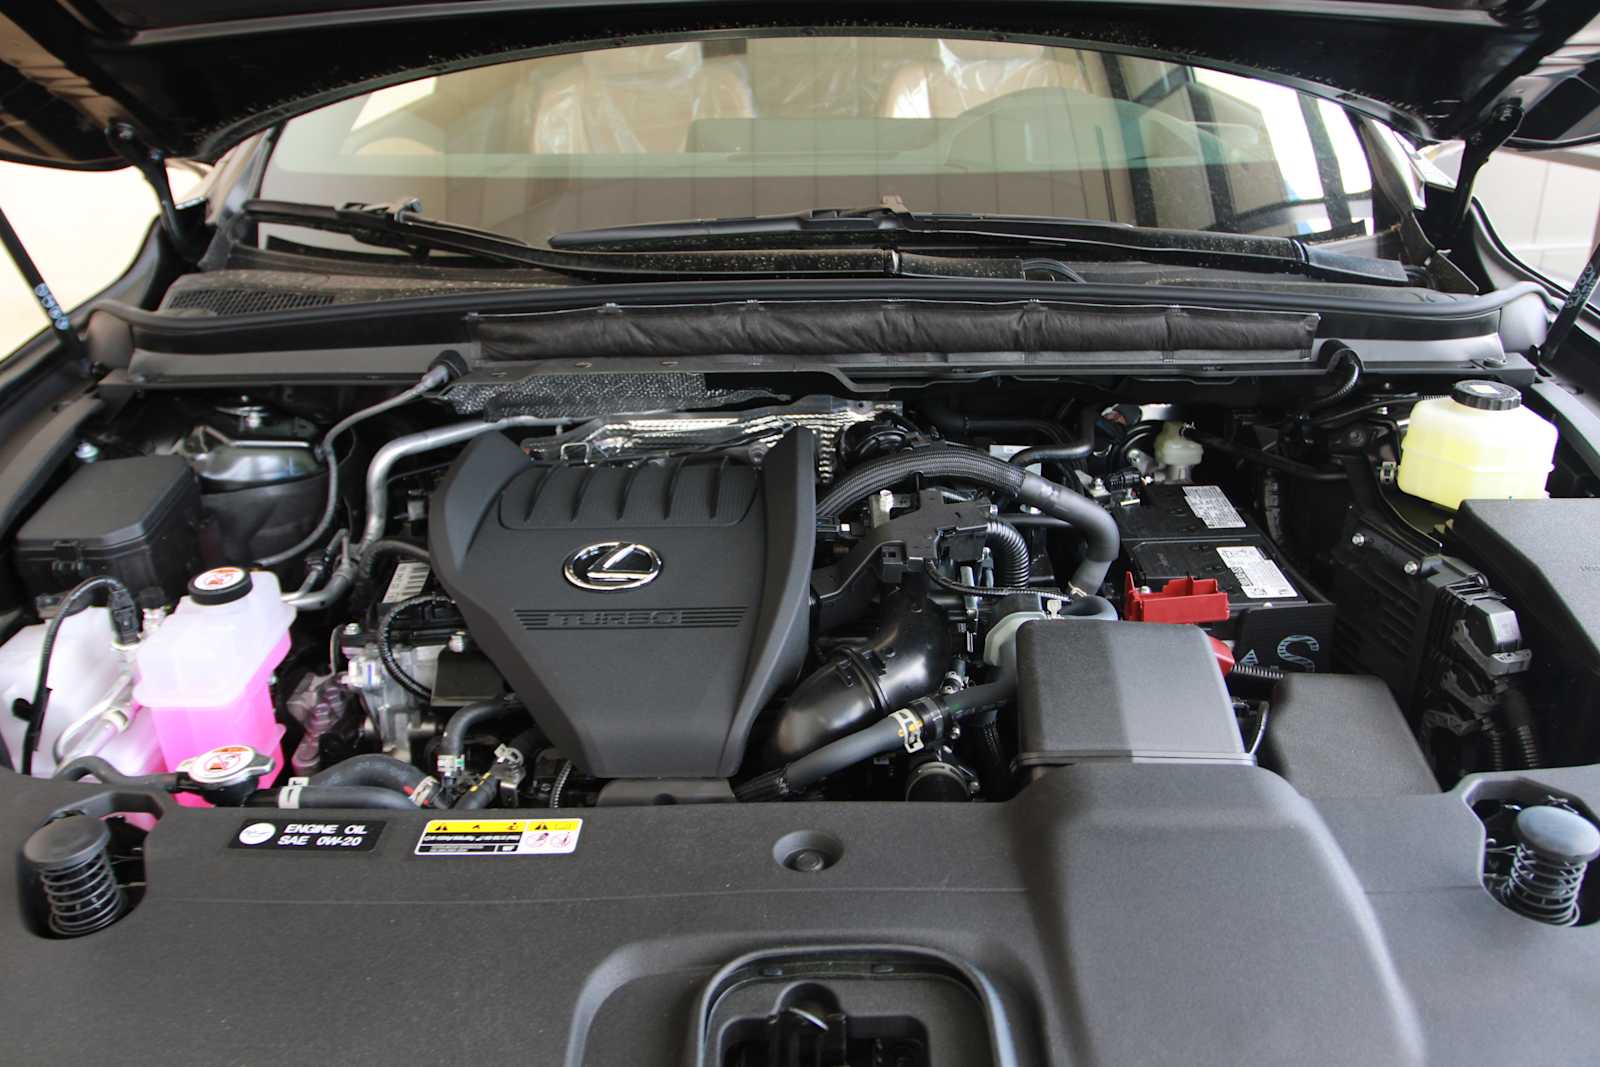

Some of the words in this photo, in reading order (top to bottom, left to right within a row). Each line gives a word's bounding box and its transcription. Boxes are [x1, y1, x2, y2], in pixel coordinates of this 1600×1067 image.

[551, 611, 680, 624] TURBO
[284, 824, 338, 834] ENGINE
[345, 824, 368, 835] OIL
[277, 835, 309, 846] SAE
[316, 836, 362, 847] 0W-20
